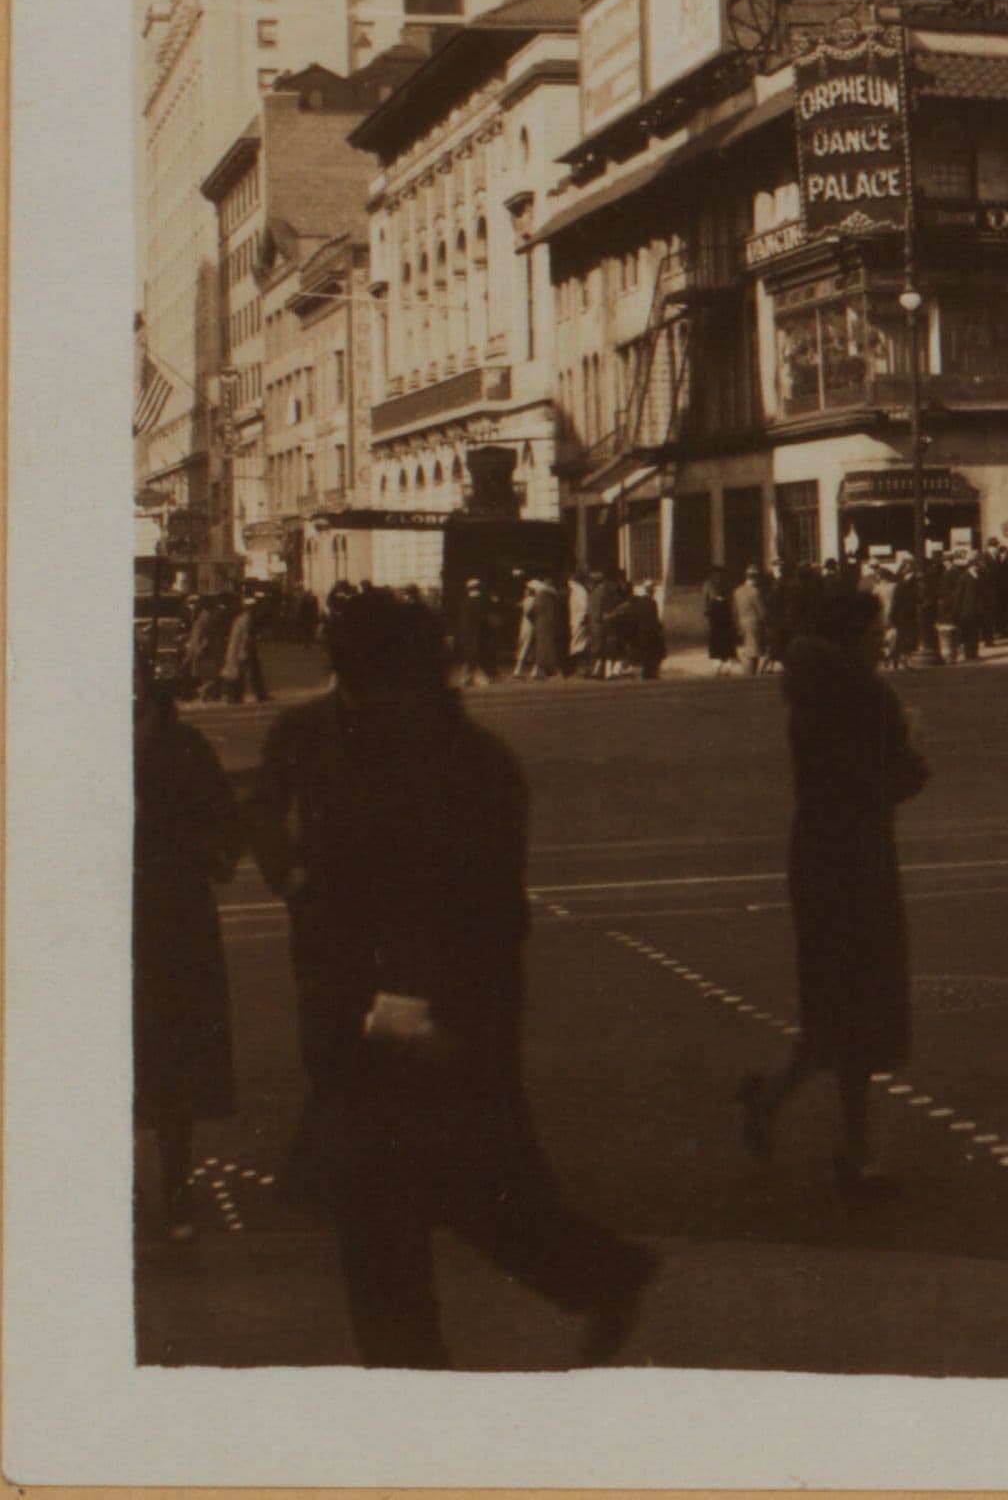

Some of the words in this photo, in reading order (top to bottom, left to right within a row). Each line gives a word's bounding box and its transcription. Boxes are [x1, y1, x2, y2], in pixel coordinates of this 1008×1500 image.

[801, 75, 899, 120] ORPHEUM
[813, 124, 891, 157] DANCE
[808, 167, 901, 202] PALACE
